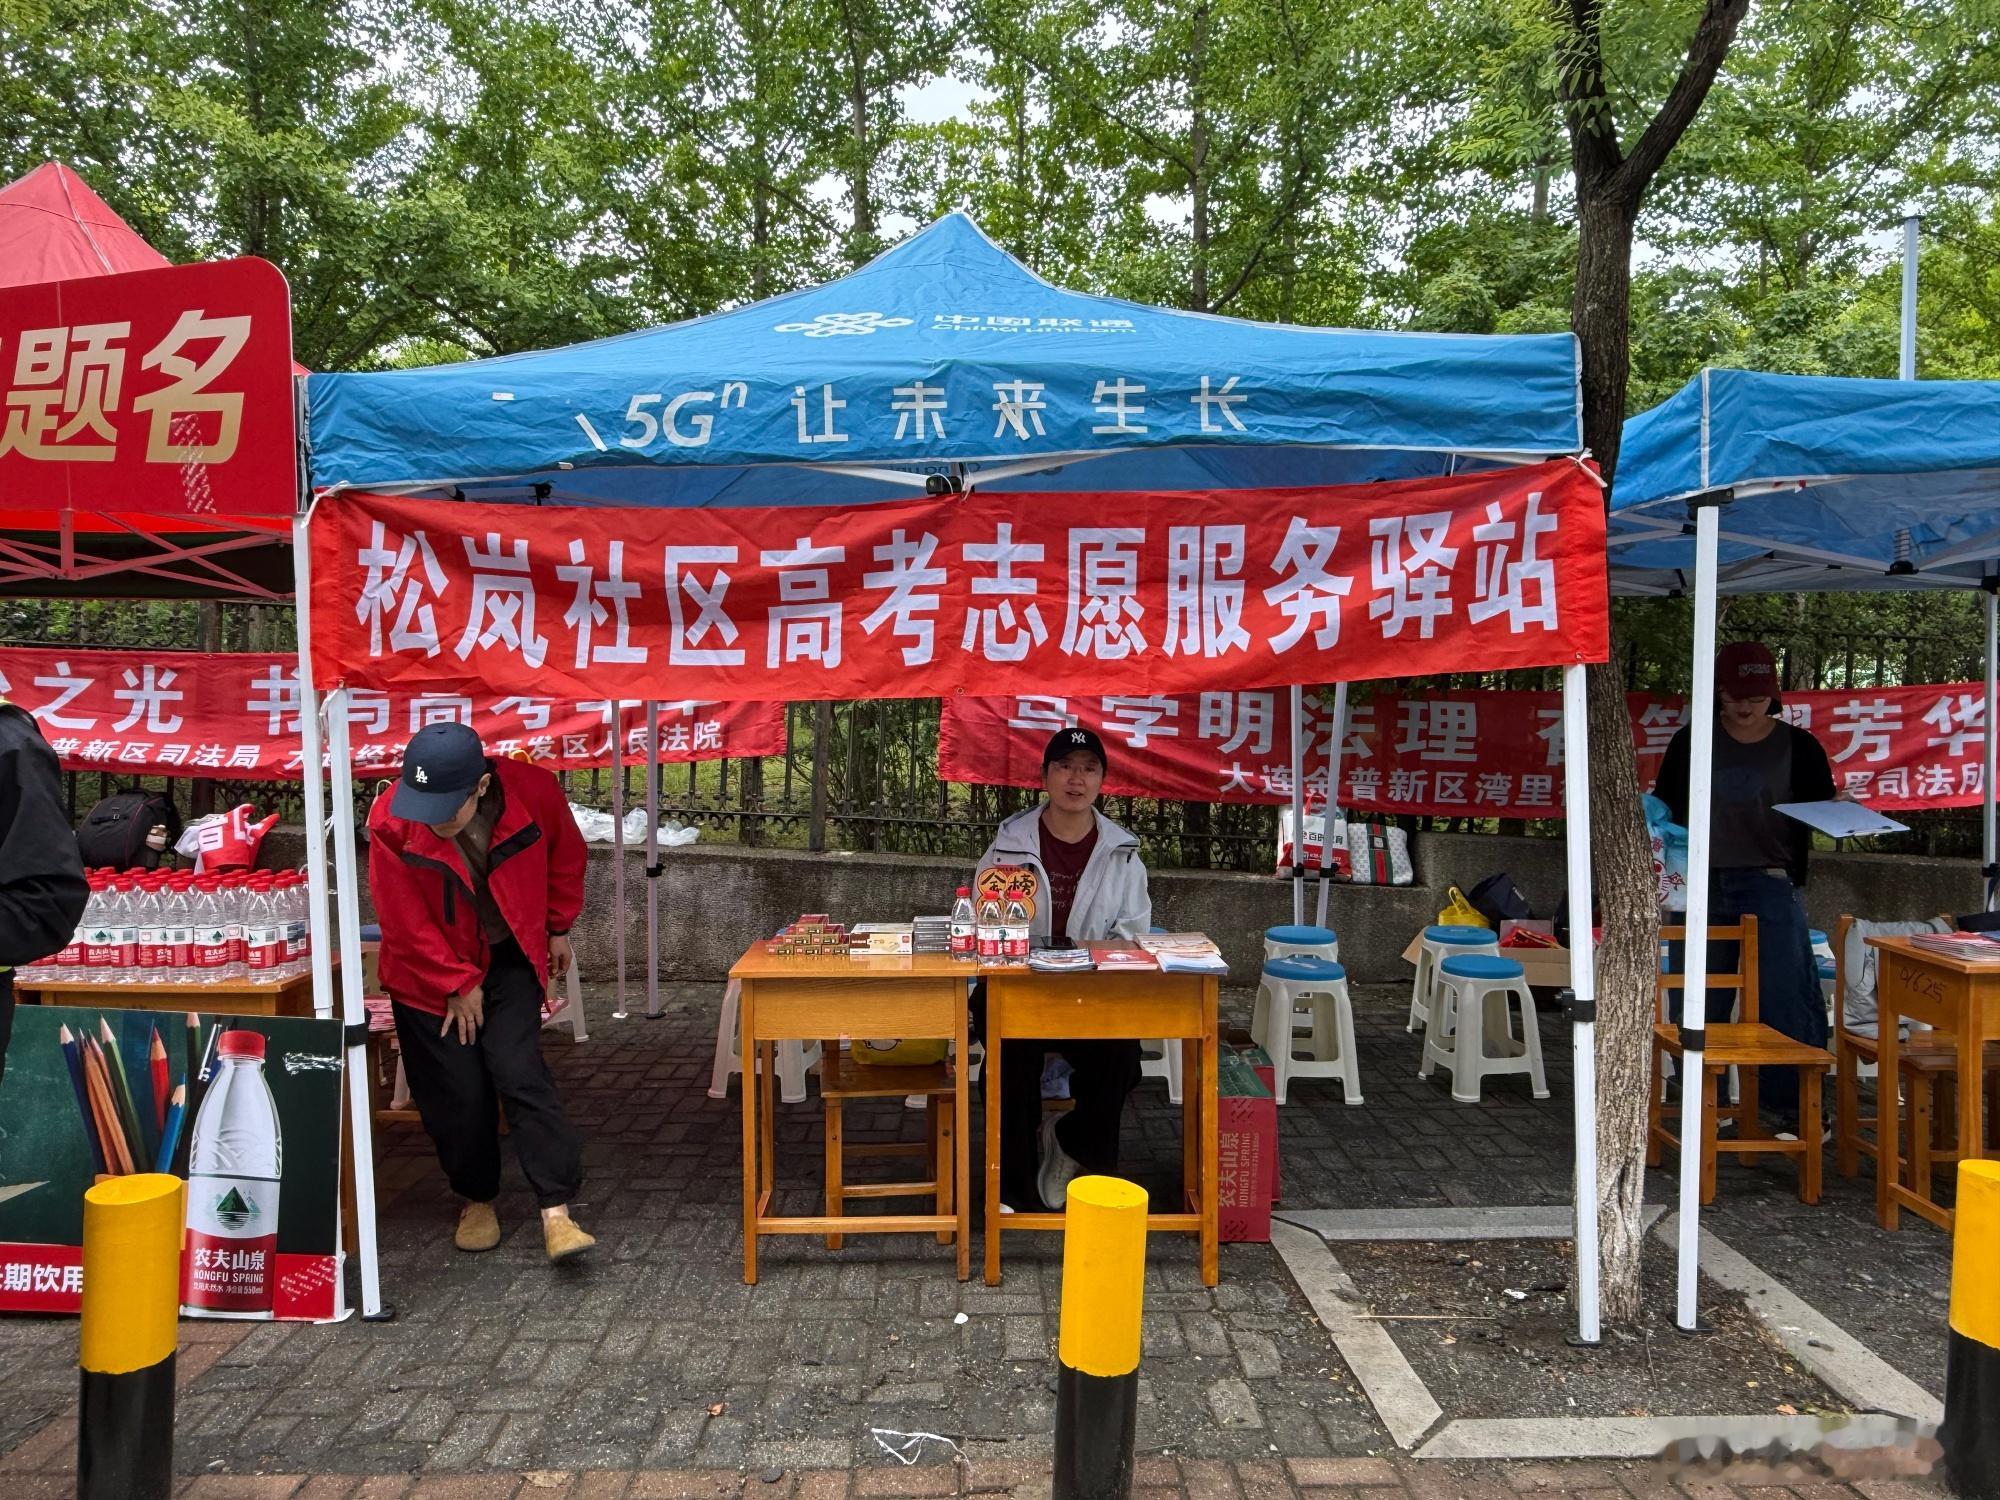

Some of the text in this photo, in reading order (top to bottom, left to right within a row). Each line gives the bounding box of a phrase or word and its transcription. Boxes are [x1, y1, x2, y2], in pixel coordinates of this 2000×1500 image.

[931, 323, 1018, 333] China
[934, 313, 1134, 328] 中国联通
[0, 309, 252, 464] 题名
[790, 375, 1249, 444] 让未来生长
[355, 491, 1559, 670] 松岚社区高考志愿服务驿站
[0, 662, 184, 734] 之光
[1071, 732, 1086, 744] NY
[415, 766, 428, 784] LA
[1219, 761, 1985, 807] 大连金普新区湾里 里司法所
[1218, 1132, 1240, 1208] 农夫山泉
[1239, 1132, 1251, 1208] NONGFU SPRING
[193, 1270, 264, 1284] NONGFU SPRING
[194, 1247, 266, 1271] 农夫山泉
